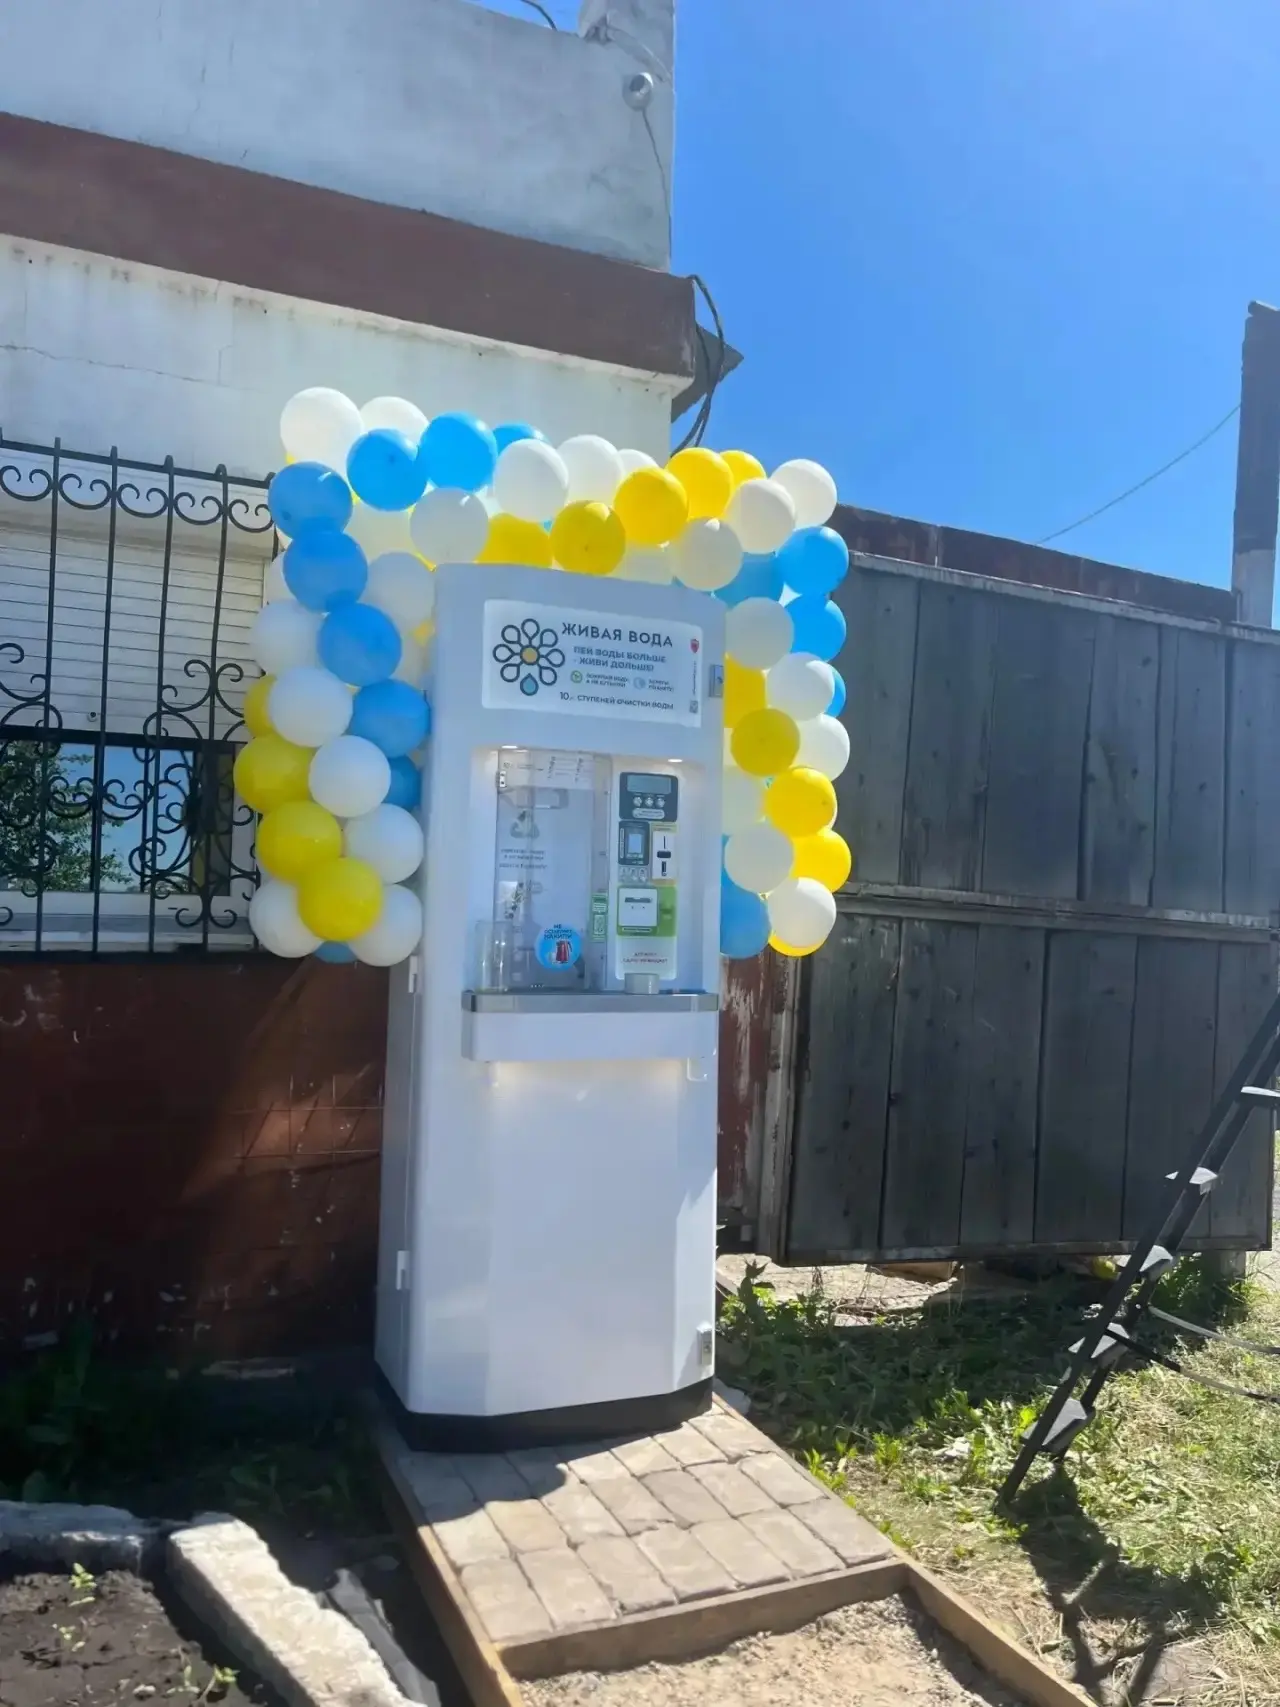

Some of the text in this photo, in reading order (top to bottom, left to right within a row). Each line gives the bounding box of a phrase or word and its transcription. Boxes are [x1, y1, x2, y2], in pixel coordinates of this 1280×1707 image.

[562, 622, 673, 647] ЖИВАЯ ВОДА
[579, 657, 608, 667] ЖИВИ
[594, 648, 625, 659] ВОДЫ
[626, 652, 666, 663] БОЛЬШЕ
[577, 695, 615, 705] СТУПЕНЕЙ
[616, 698, 650, 708] ОЧИСТКИ
[652, 701, 674, 710] ВОДЫ
